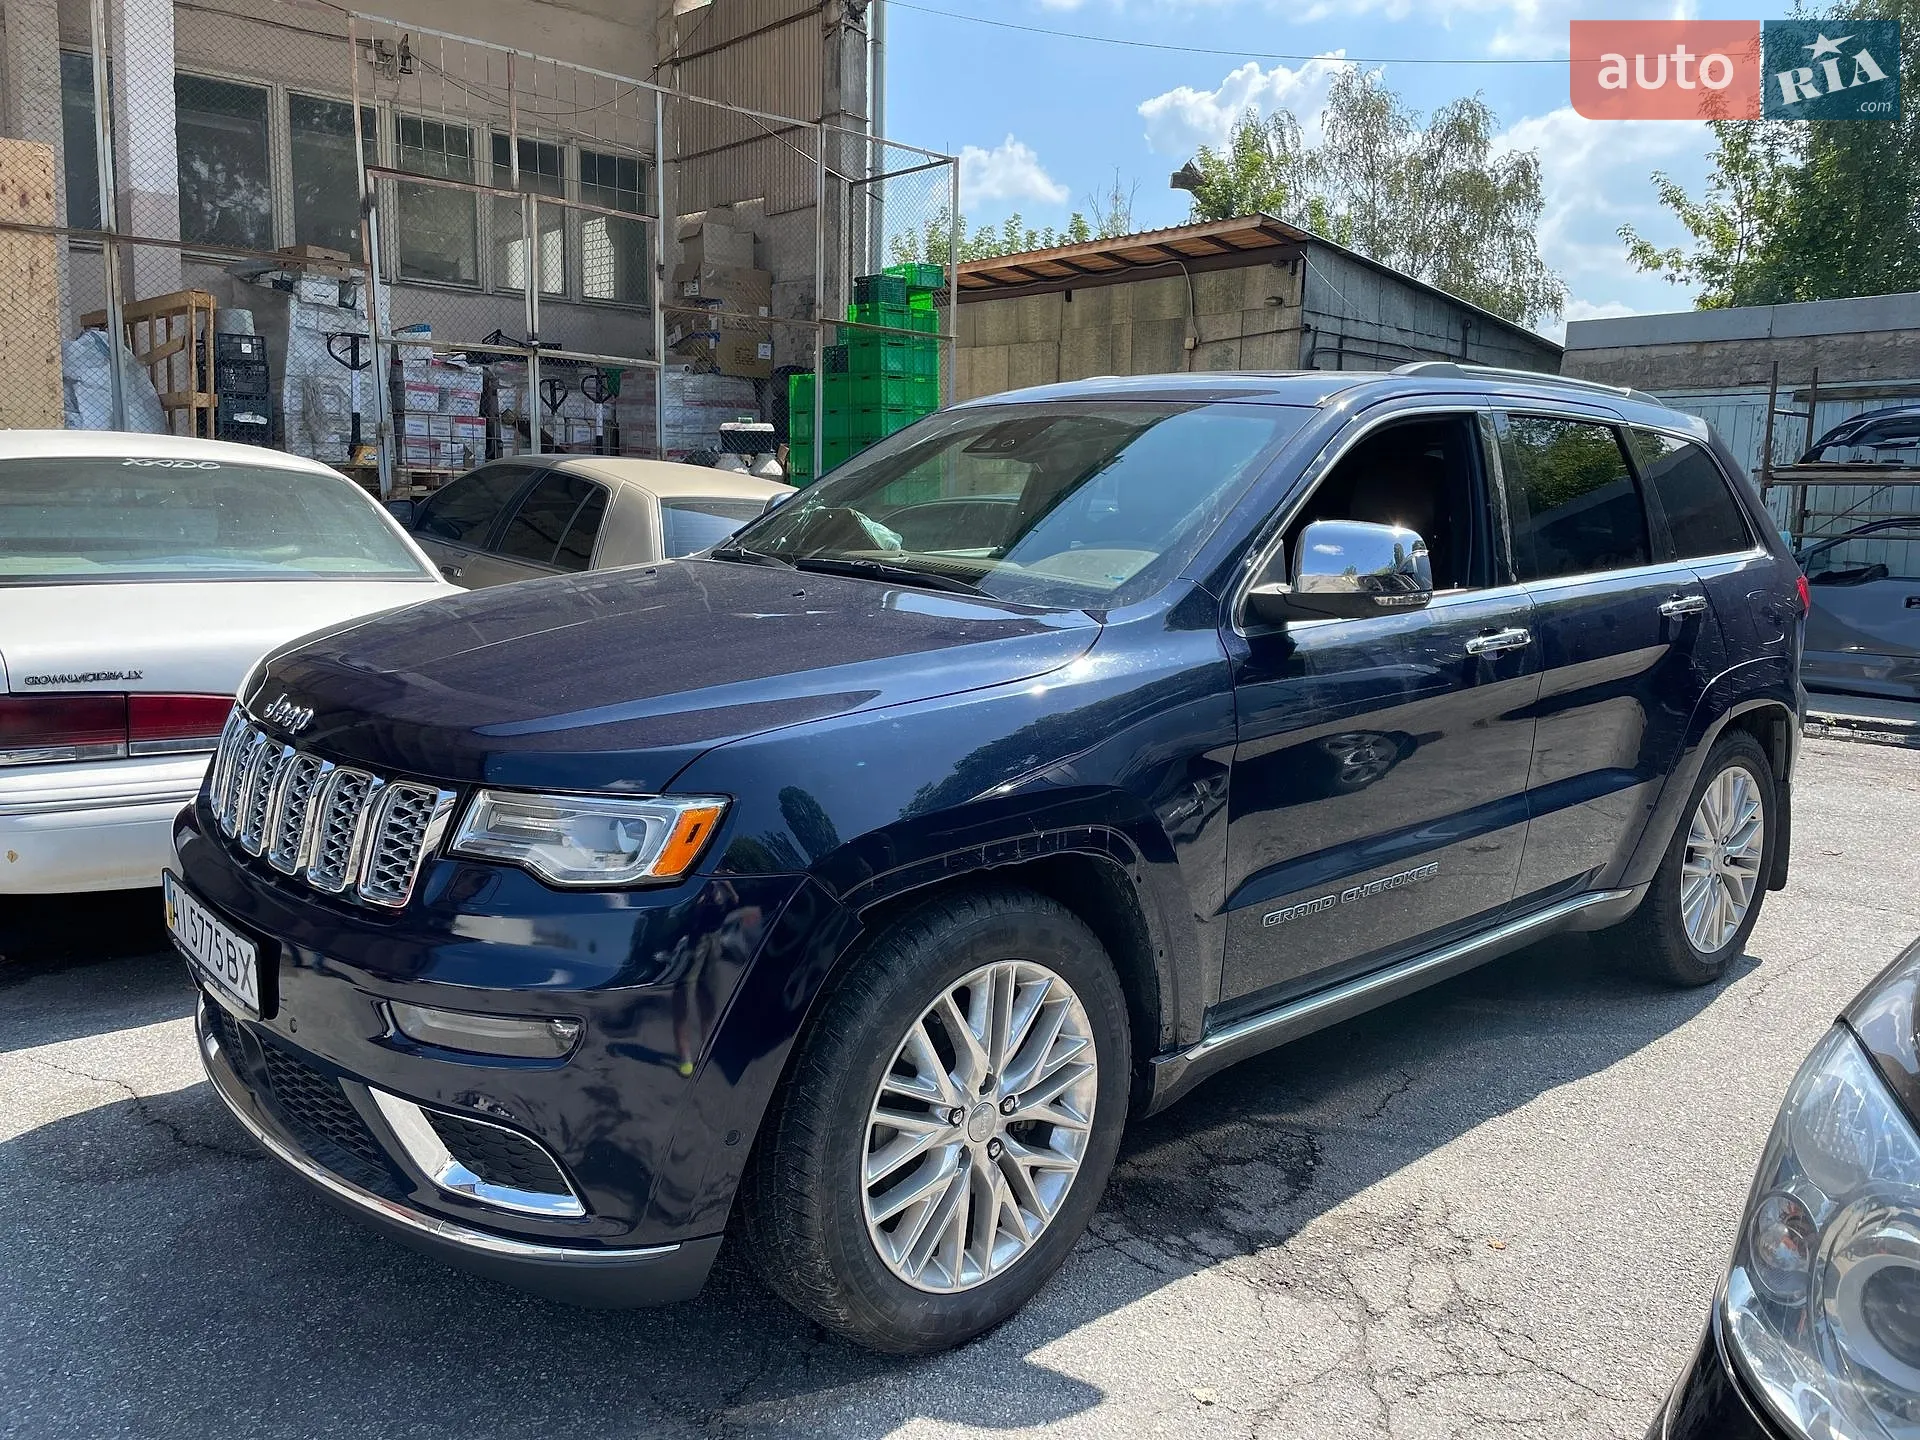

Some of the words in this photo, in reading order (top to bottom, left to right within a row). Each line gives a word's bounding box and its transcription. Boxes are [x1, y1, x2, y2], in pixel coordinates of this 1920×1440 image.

[263, 693, 315, 735] Jeep
[1262, 894, 1337, 928] GRAND
[1341, 861, 1439, 904] CHEROKEE
